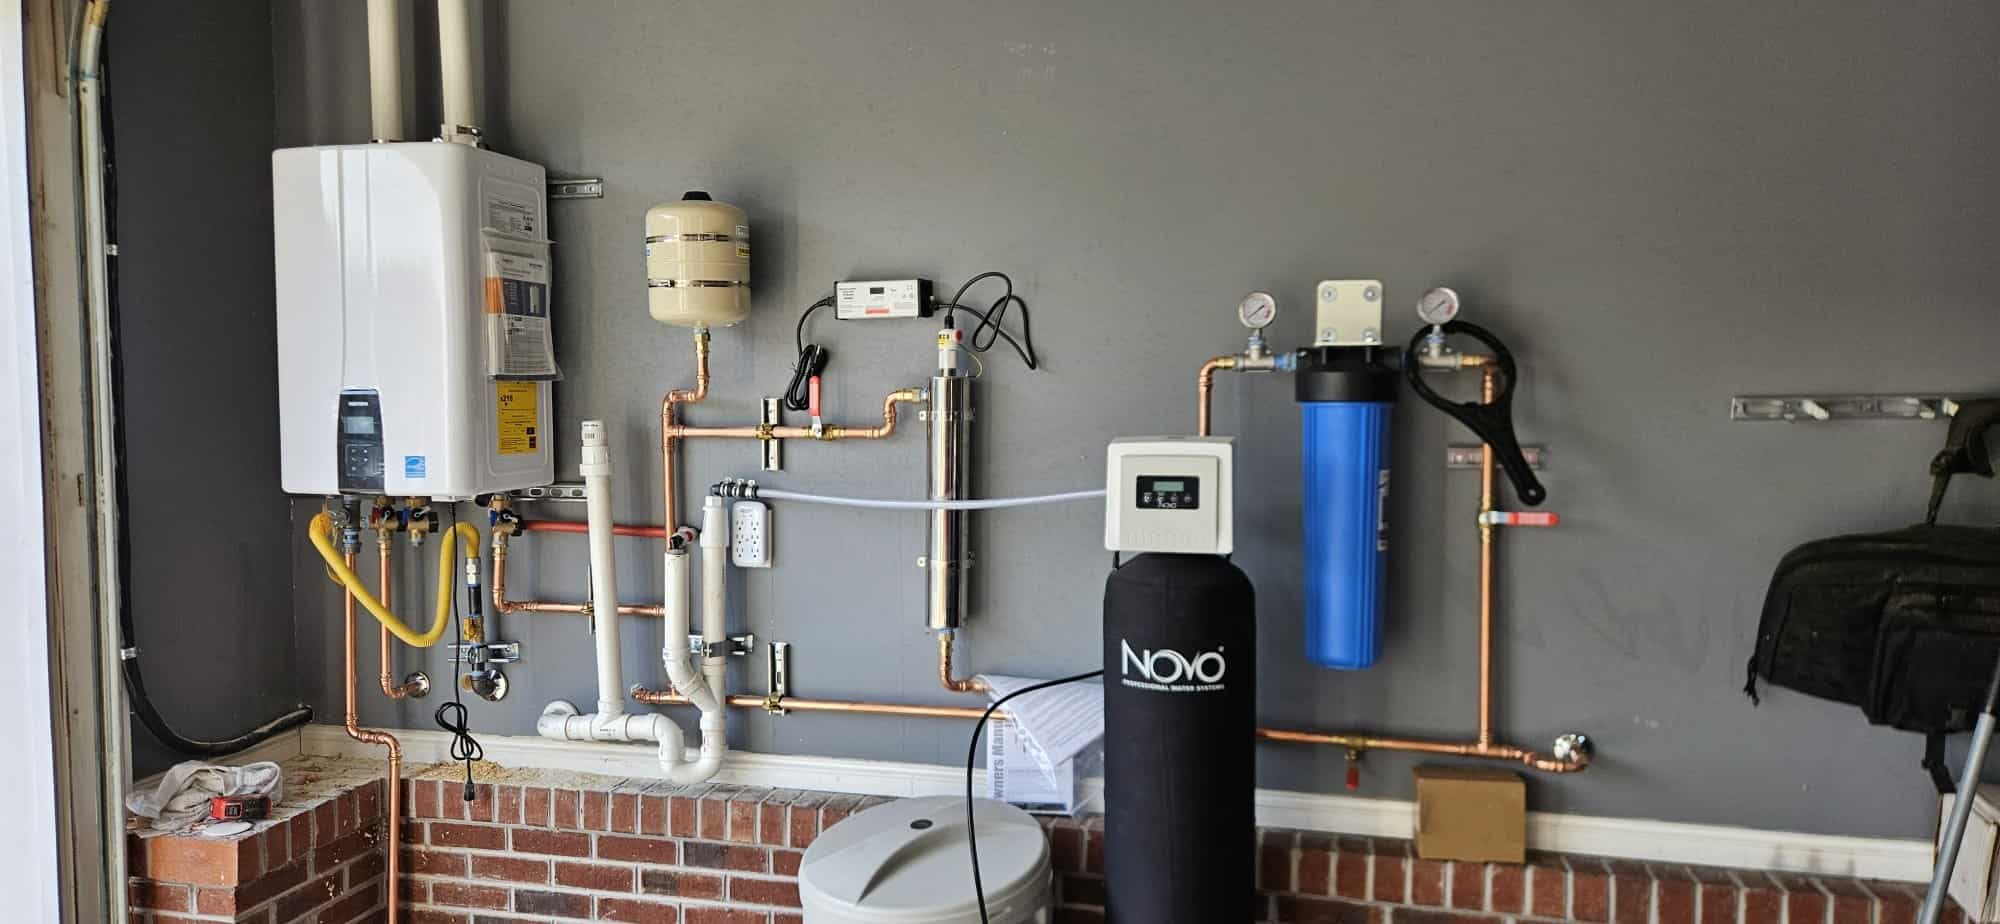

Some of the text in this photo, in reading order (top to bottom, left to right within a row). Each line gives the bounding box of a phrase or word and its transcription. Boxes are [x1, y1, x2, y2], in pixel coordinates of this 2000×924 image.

[1121, 638, 1226, 684] NOVO
[992, 720, 1004, 799] wners Manu
